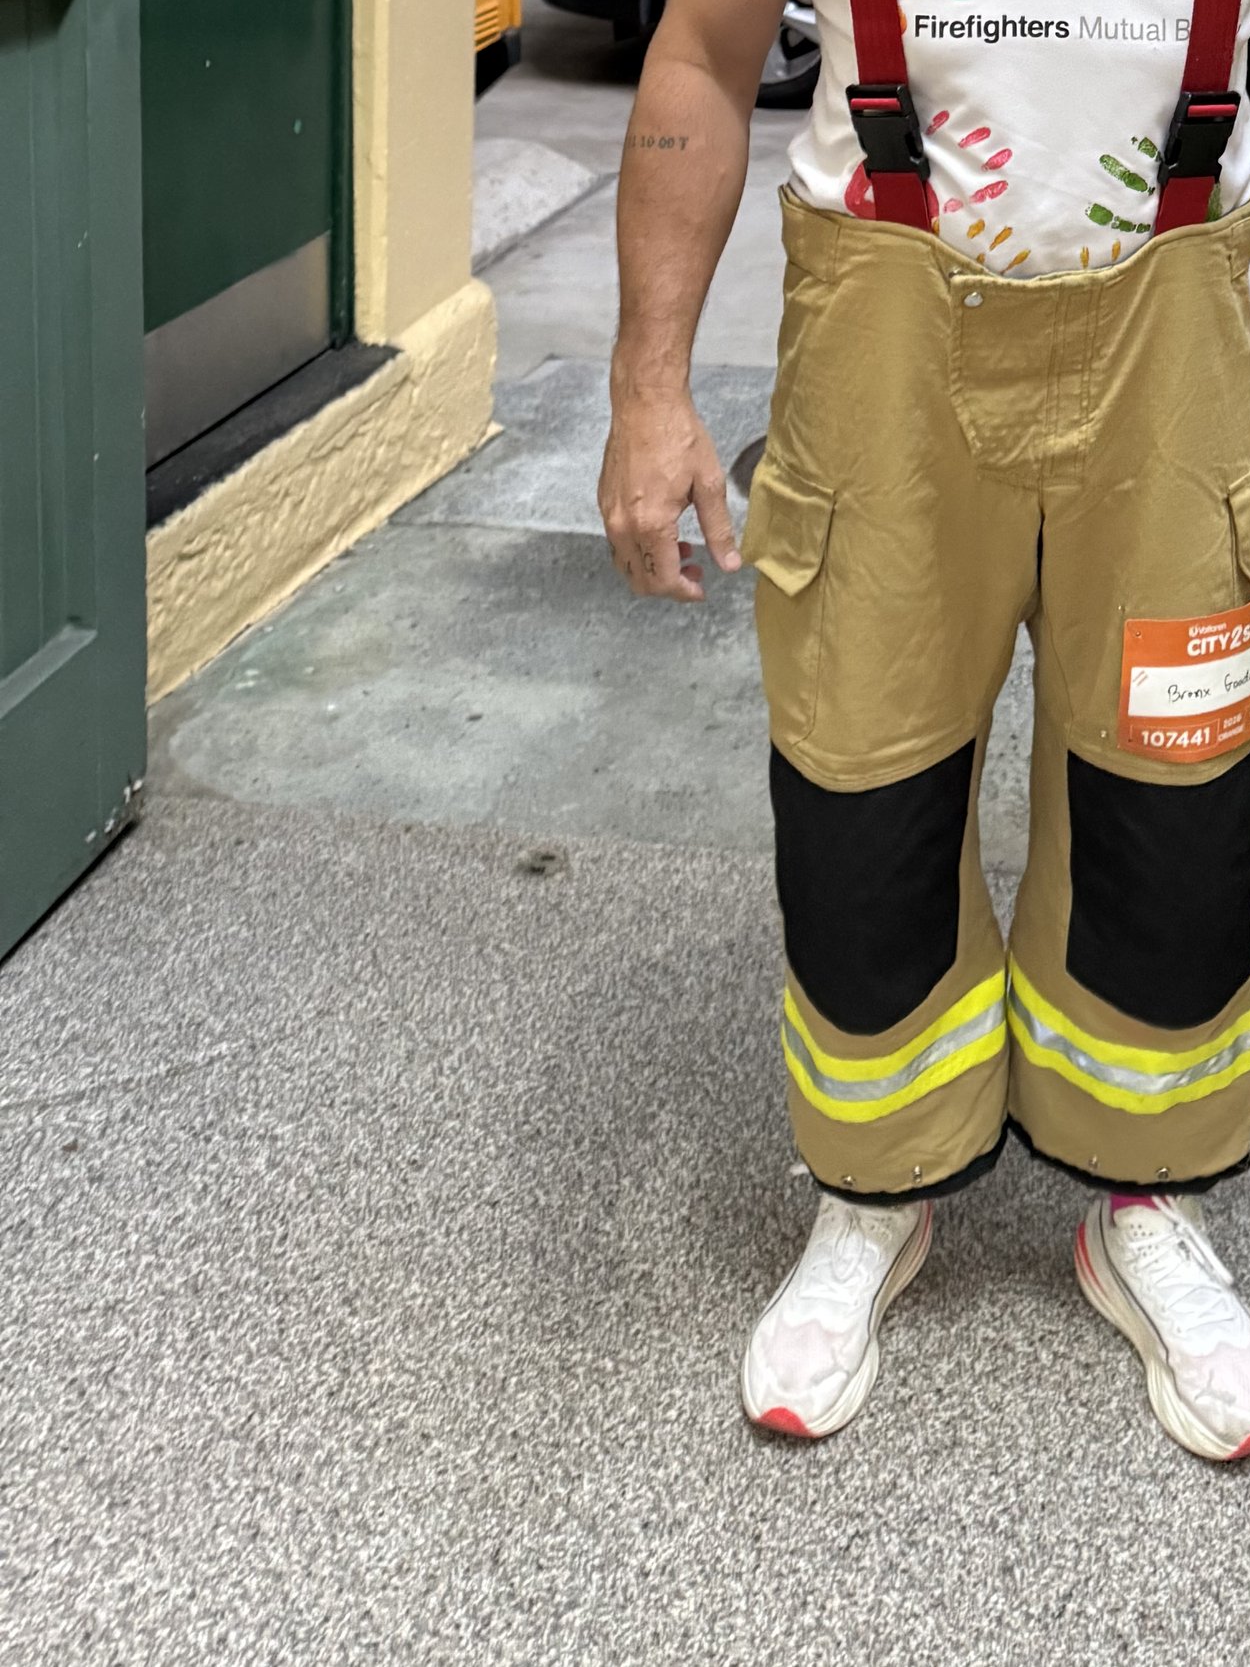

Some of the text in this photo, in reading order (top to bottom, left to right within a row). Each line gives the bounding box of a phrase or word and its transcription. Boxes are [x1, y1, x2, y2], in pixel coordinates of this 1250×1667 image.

[914, 14, 1190, 44] Firefighters Mutual B
[1141, 727, 1211, 749] 107441
